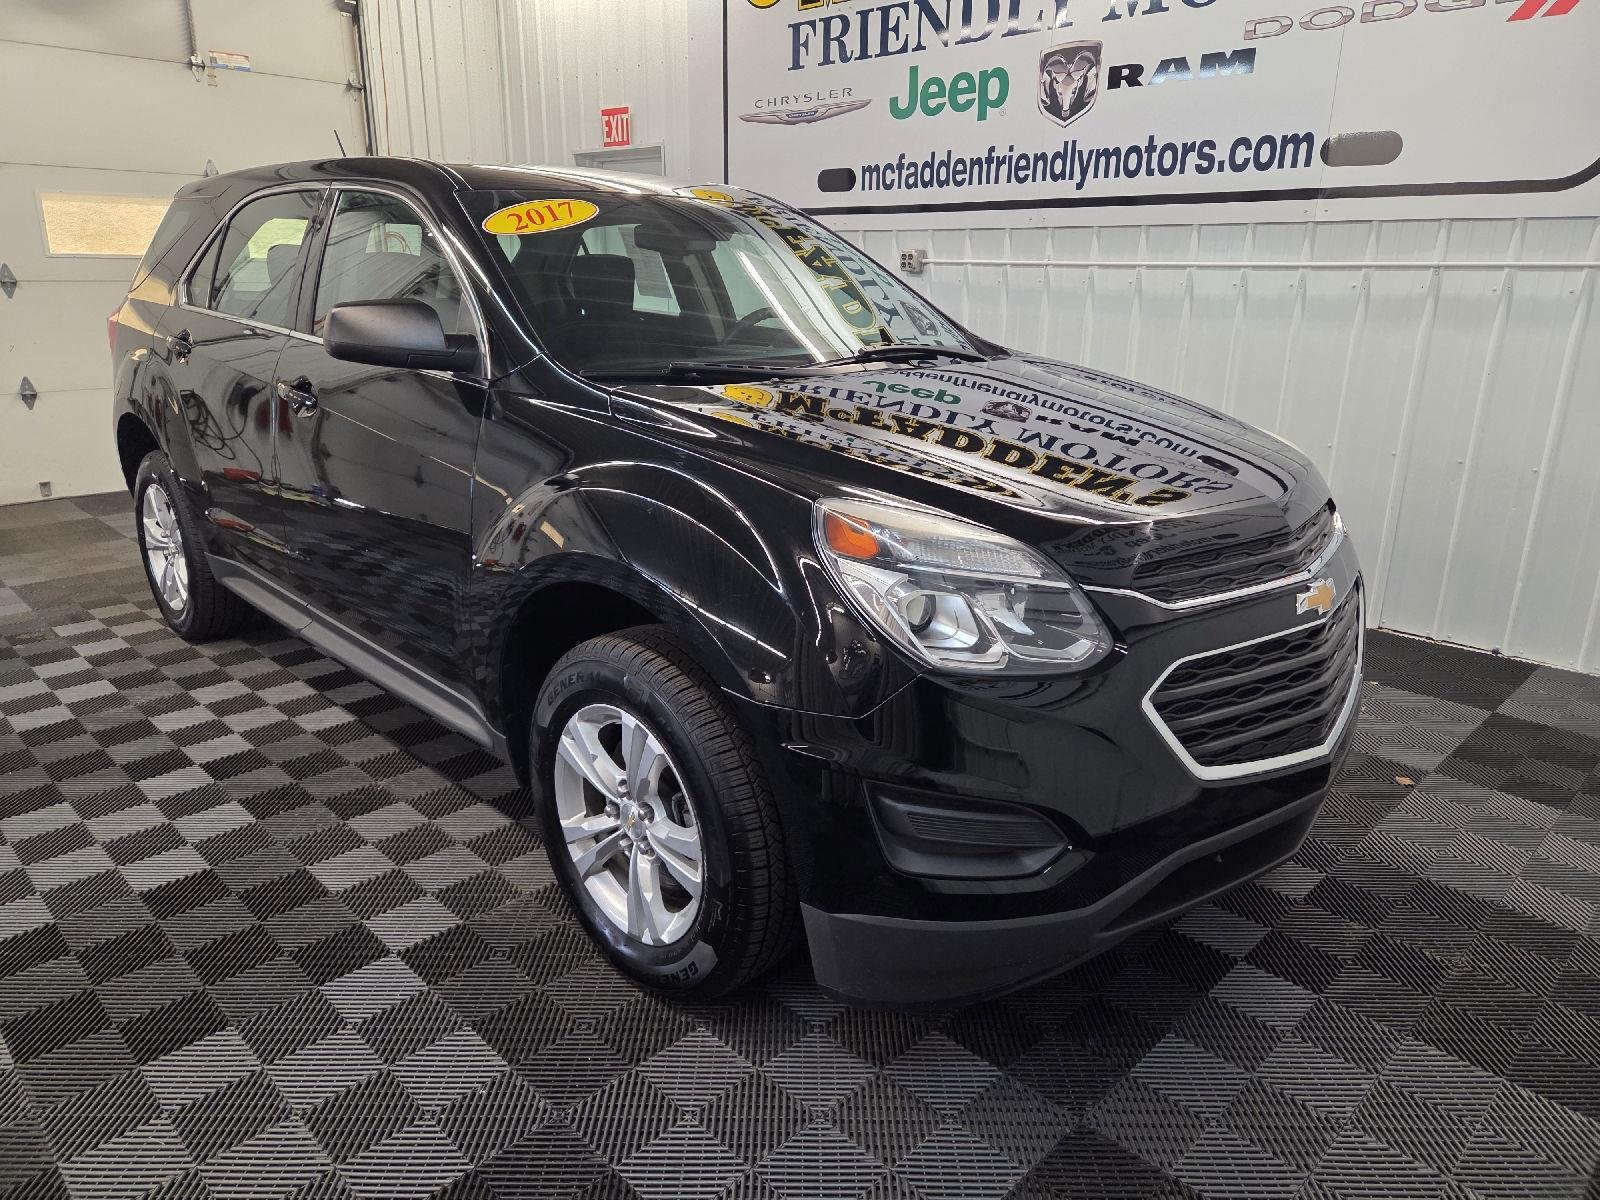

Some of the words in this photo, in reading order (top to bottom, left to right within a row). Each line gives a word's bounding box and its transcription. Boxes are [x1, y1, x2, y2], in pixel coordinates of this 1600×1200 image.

[1107, 48, 1256, 90] RAM
[755, 87, 852, 108] CHRYSLER
[889, 65, 1009, 121] Jeep
[602, 114, 629, 143] EXIT
[861, 131, 1315, 191] mcfaddenfriendlymotors.com
[507, 202, 575, 231] 2017
